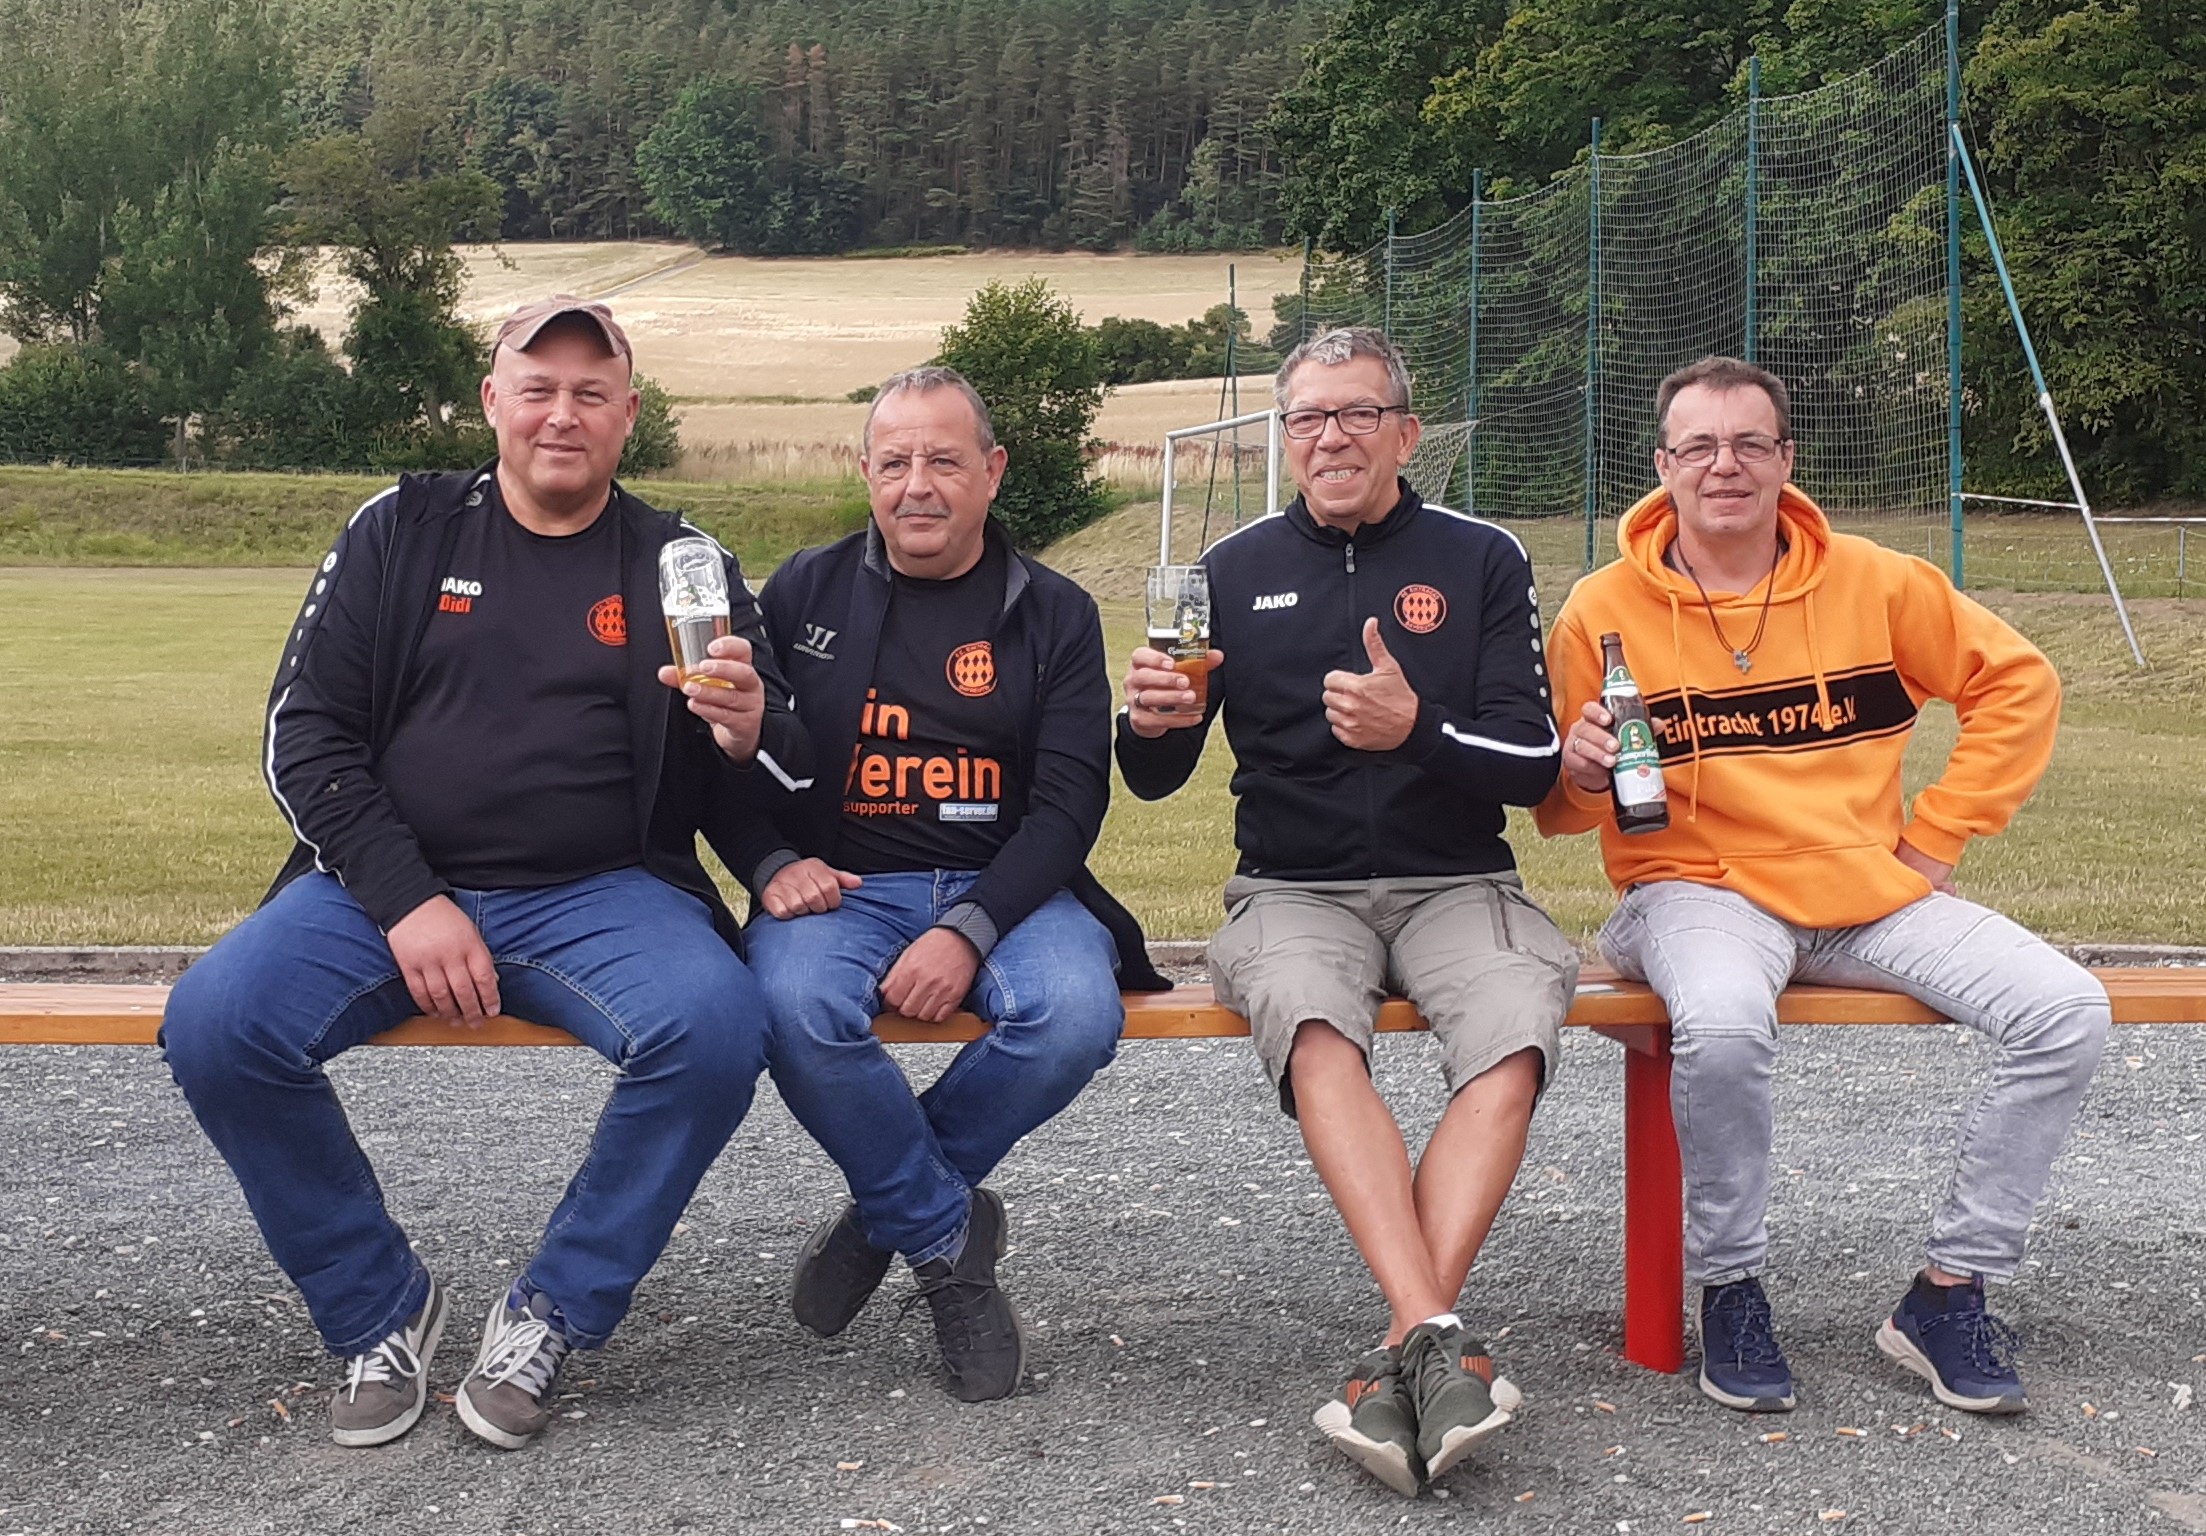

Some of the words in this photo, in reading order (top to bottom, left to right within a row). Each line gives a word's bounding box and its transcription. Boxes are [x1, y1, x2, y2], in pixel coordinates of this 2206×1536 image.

[1253, 593, 1297, 610] JAKO
[1664, 711, 1764, 744] Eintracht
[1767, 703, 1825, 735] 1974
[844, 801, 919, 817] supporter
